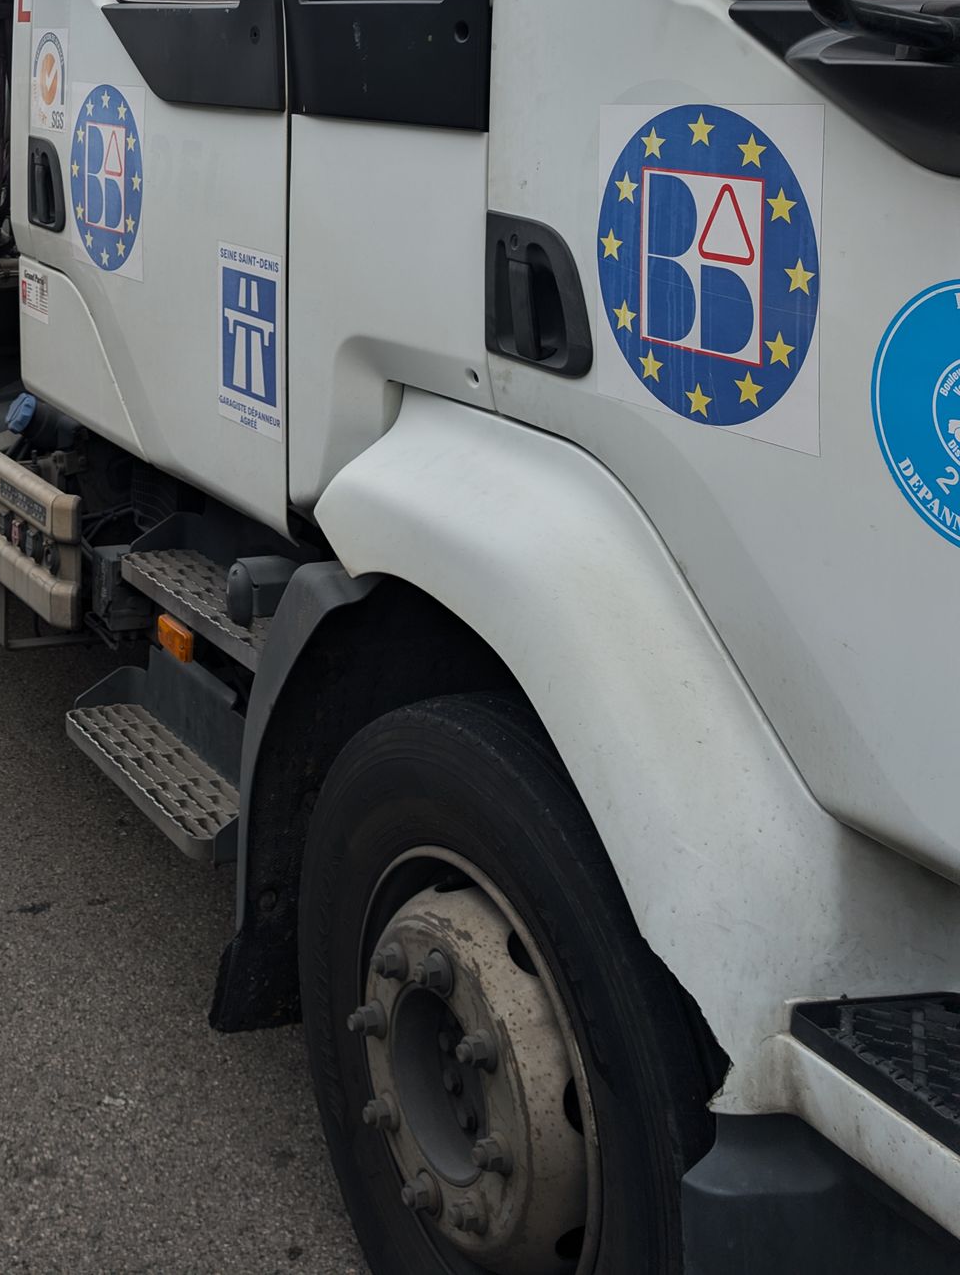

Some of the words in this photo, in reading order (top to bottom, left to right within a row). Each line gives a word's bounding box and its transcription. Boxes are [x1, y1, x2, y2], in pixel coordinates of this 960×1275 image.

[51, 110, 64, 129] SGS
[220, 247, 238, 262] SEINE
[239, 252, 279, 273] SAINT-DENIS
[219, 394, 247, 414] GARAGISTE
[248, 407, 281, 428] DÉPANNEUR
